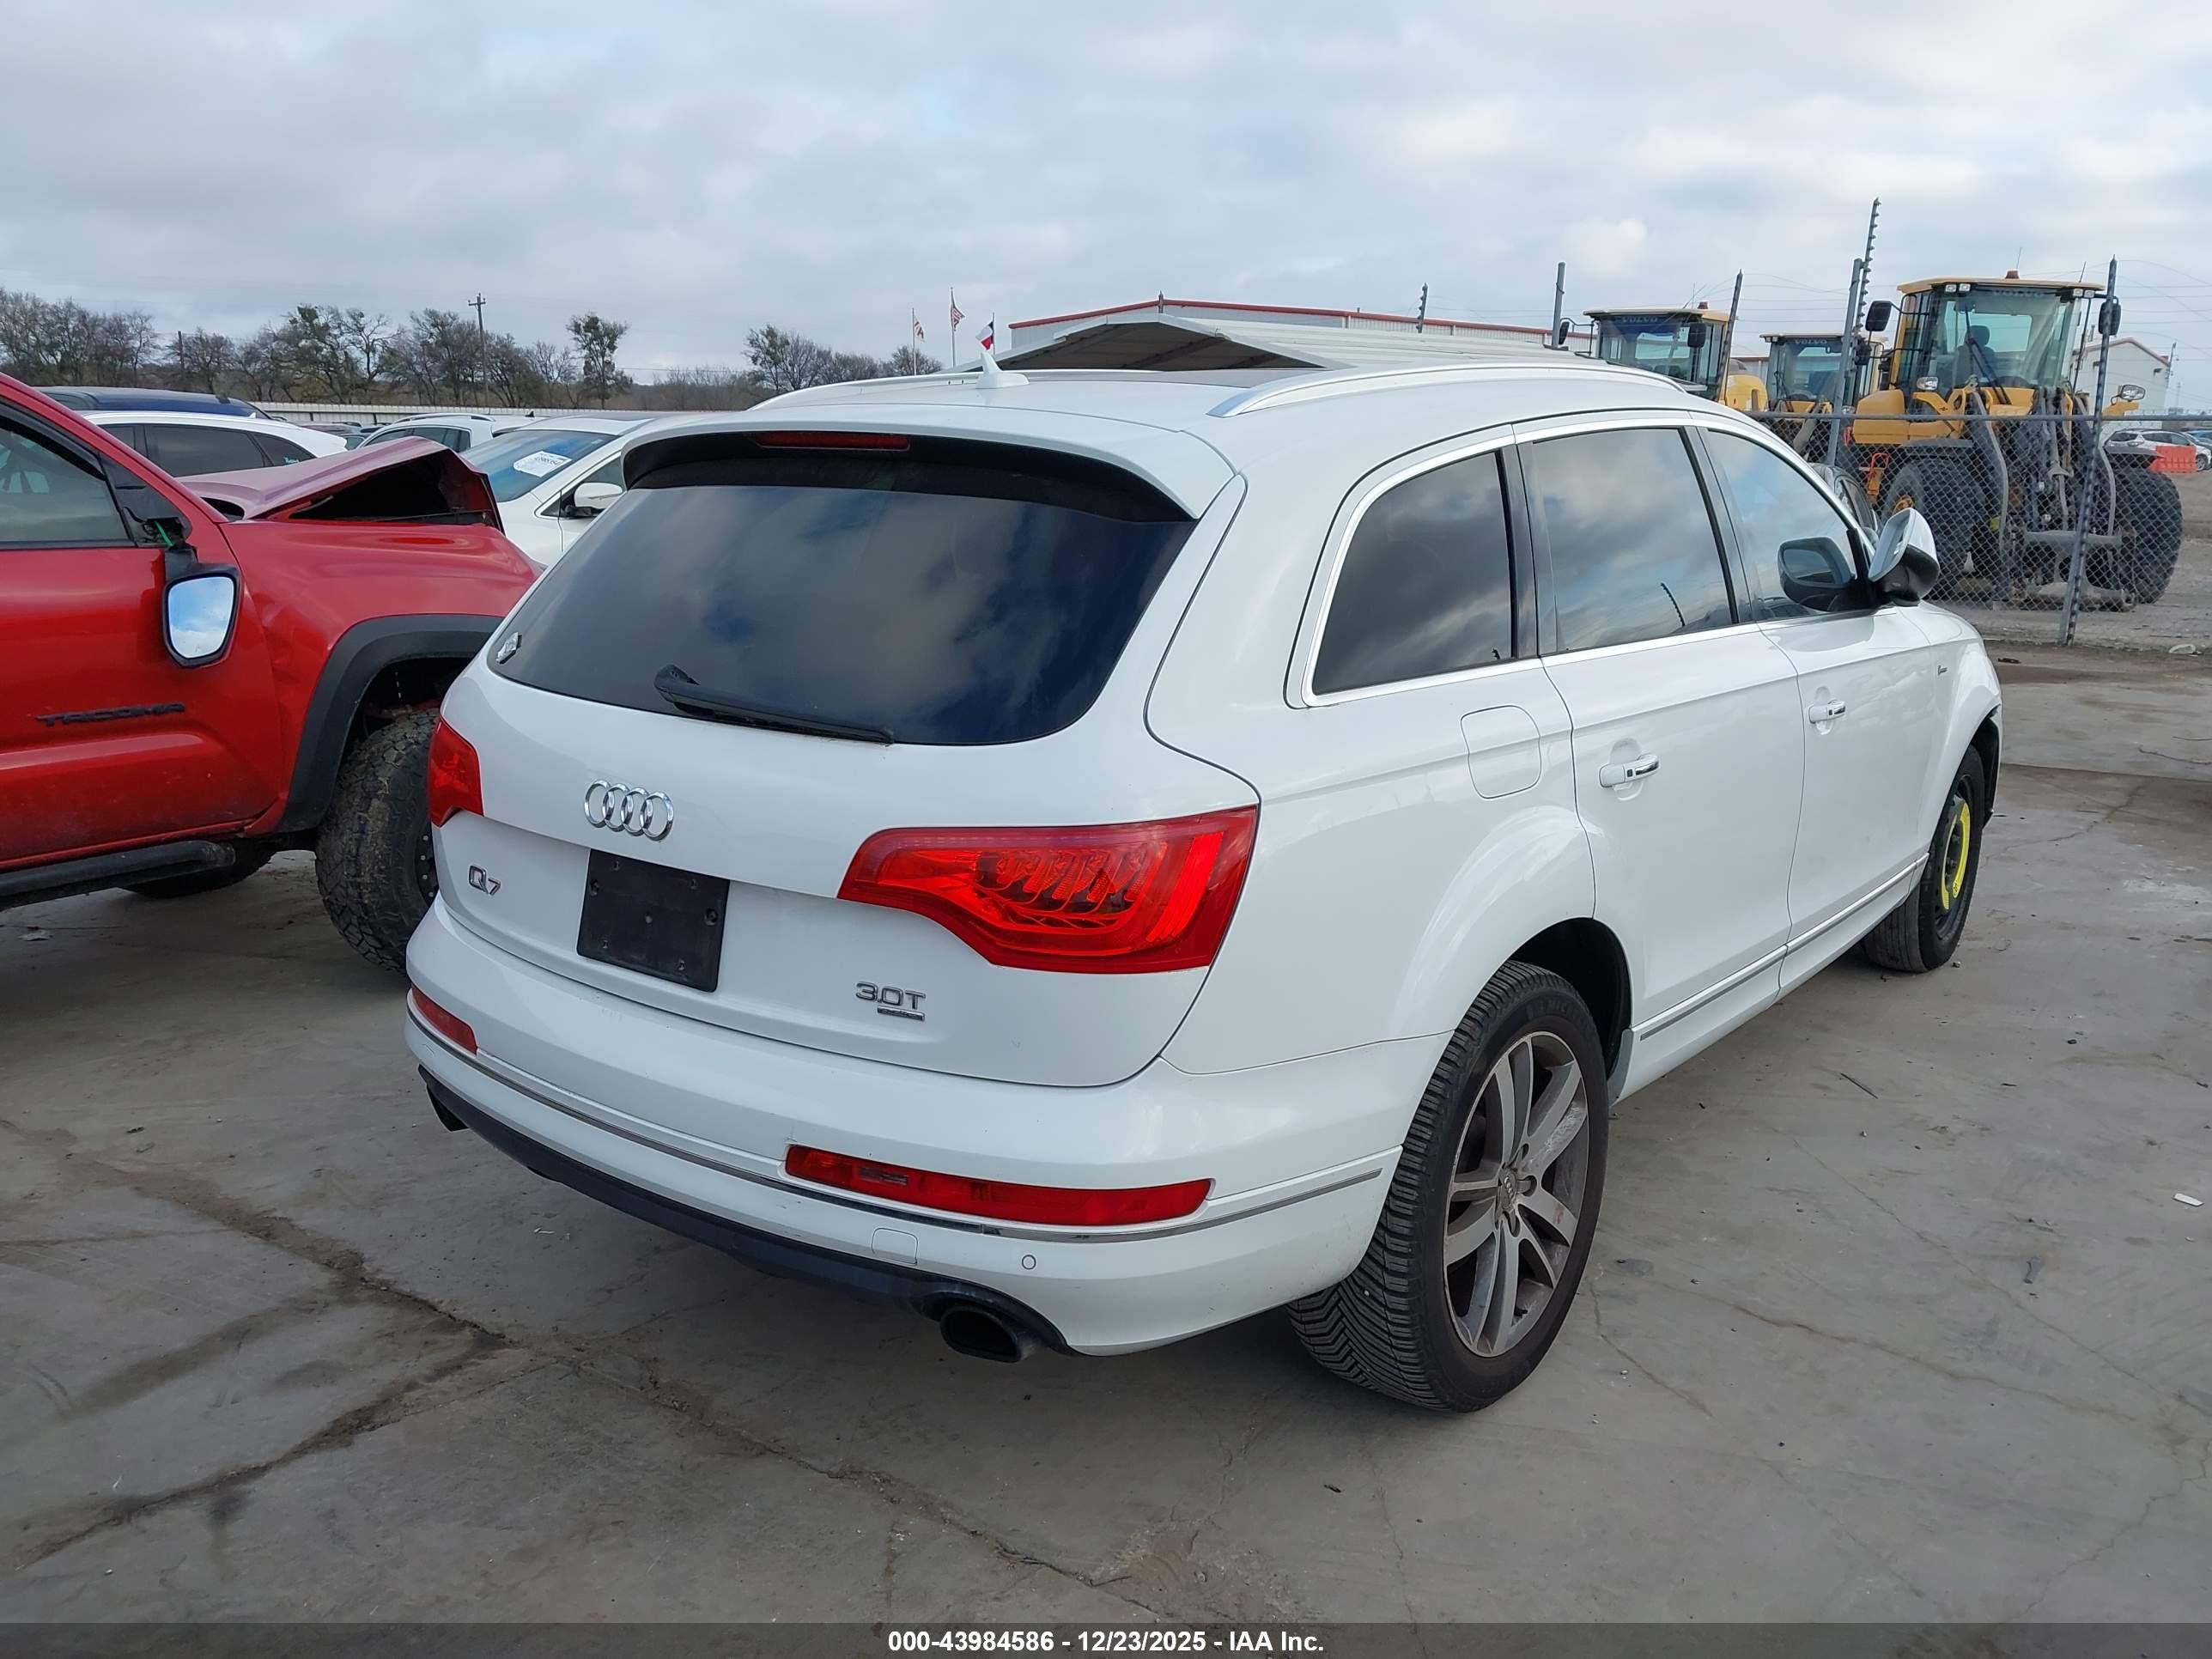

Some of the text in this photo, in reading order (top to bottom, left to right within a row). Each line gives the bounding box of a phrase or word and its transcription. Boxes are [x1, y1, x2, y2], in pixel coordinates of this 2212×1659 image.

[1621, 315, 1658, 324] VOLVO
[33, 701, 185, 727] TACOMA
[468, 865, 501, 896] Q7
[855, 981, 927, 1010] 3.0T
